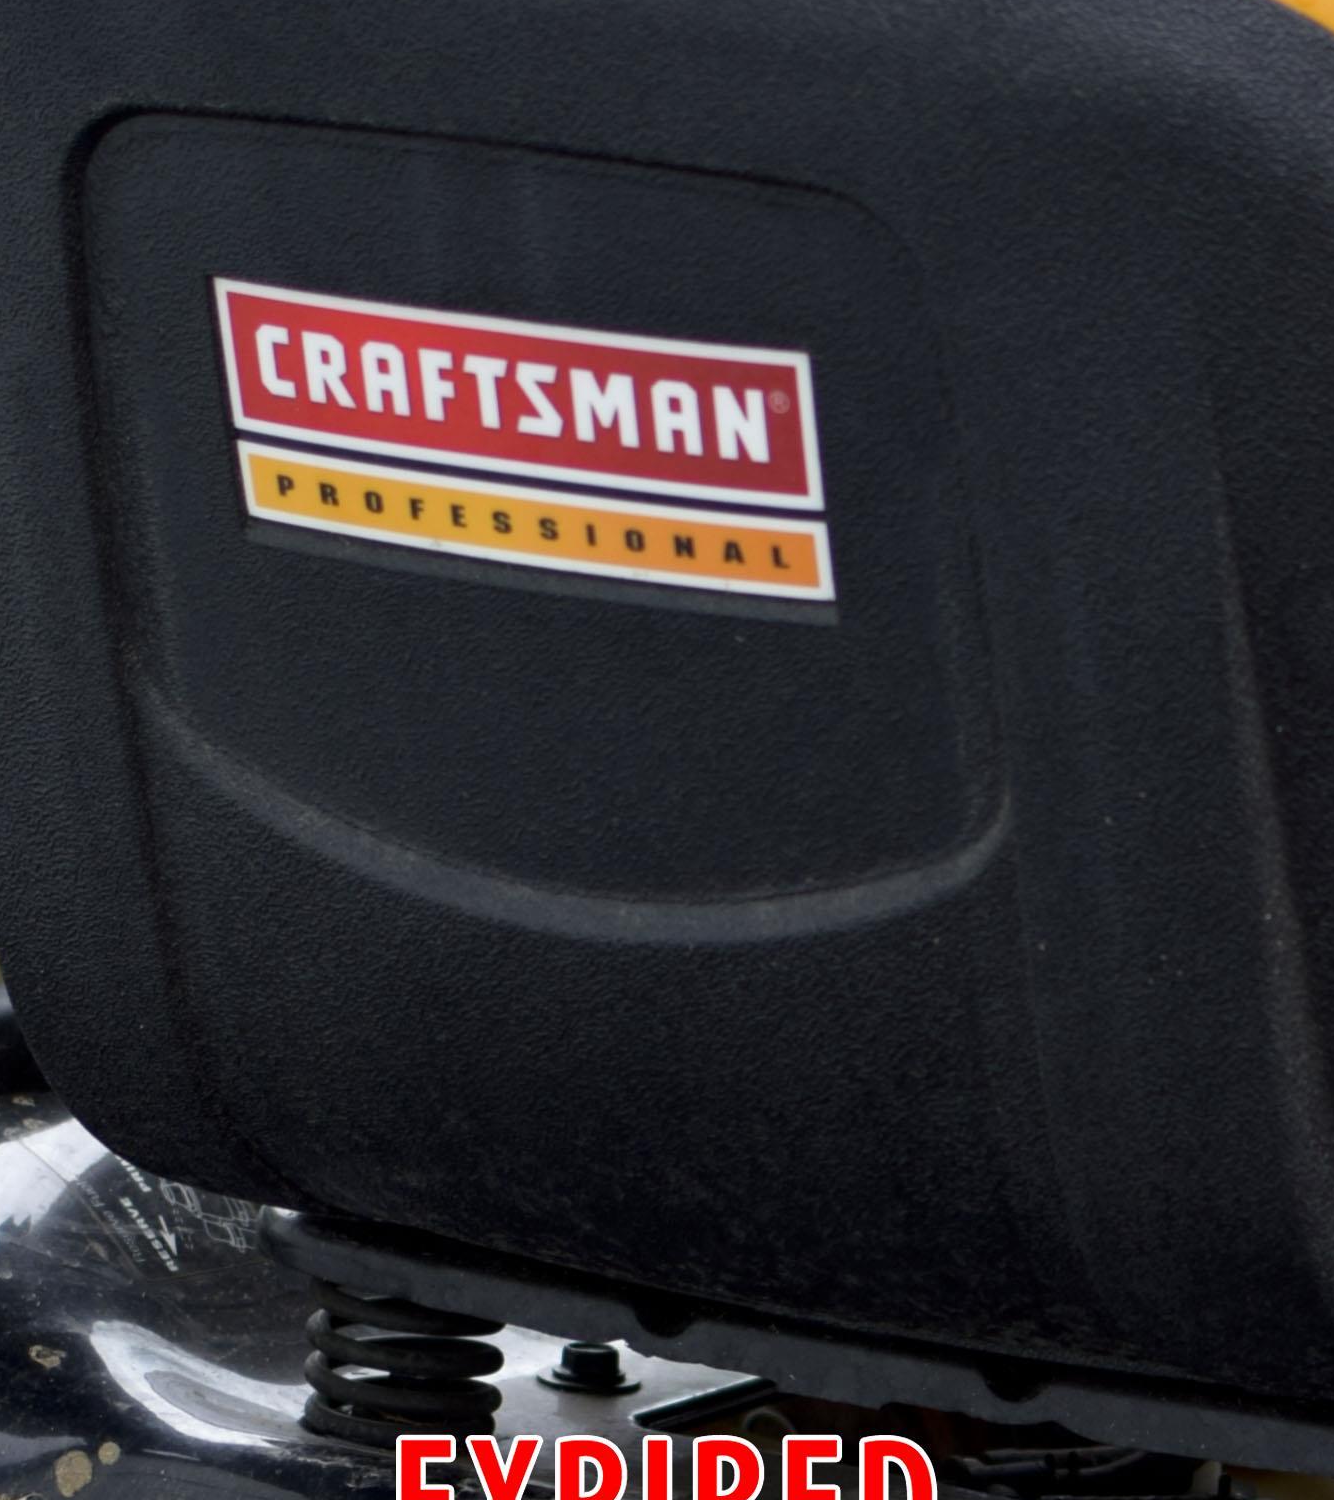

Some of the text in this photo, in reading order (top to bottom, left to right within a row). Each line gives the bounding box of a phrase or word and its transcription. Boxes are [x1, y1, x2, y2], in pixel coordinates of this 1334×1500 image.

[255, 324, 769, 463] CRAFTSMAN
[276, 473, 791, 569] PROFESSIONAL
[119, 1197, 179, 1271] RESERVE
